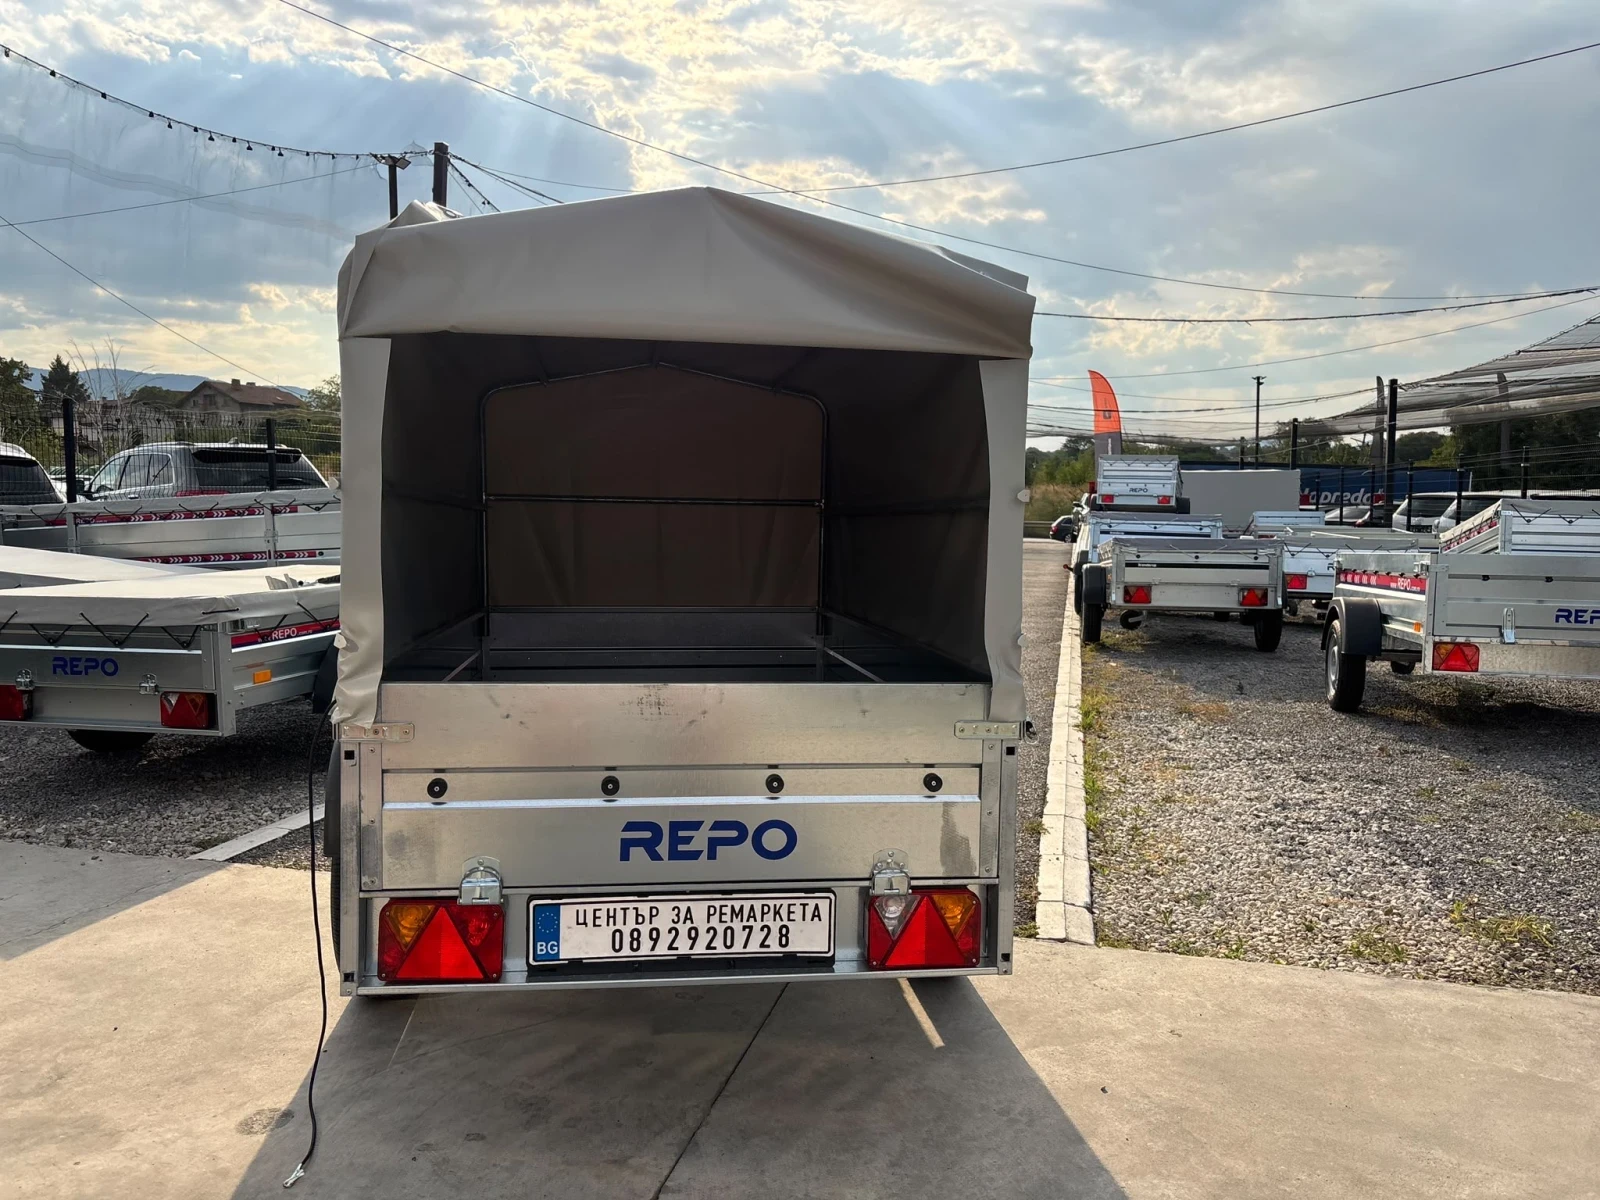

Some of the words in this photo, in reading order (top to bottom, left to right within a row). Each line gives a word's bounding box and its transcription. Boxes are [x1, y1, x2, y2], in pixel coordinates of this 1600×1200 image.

[52, 656, 119, 677] REPO
[619, 819, 798, 862] REPO
[575, 906, 660, 928] ЦЕНТЪР
[671, 905, 695, 926] ЗА
[706, 902, 822, 924] РЕМАРКЕТА
[536, 941, 559, 955] BG
[612, 924, 790, 953] 0892920728
